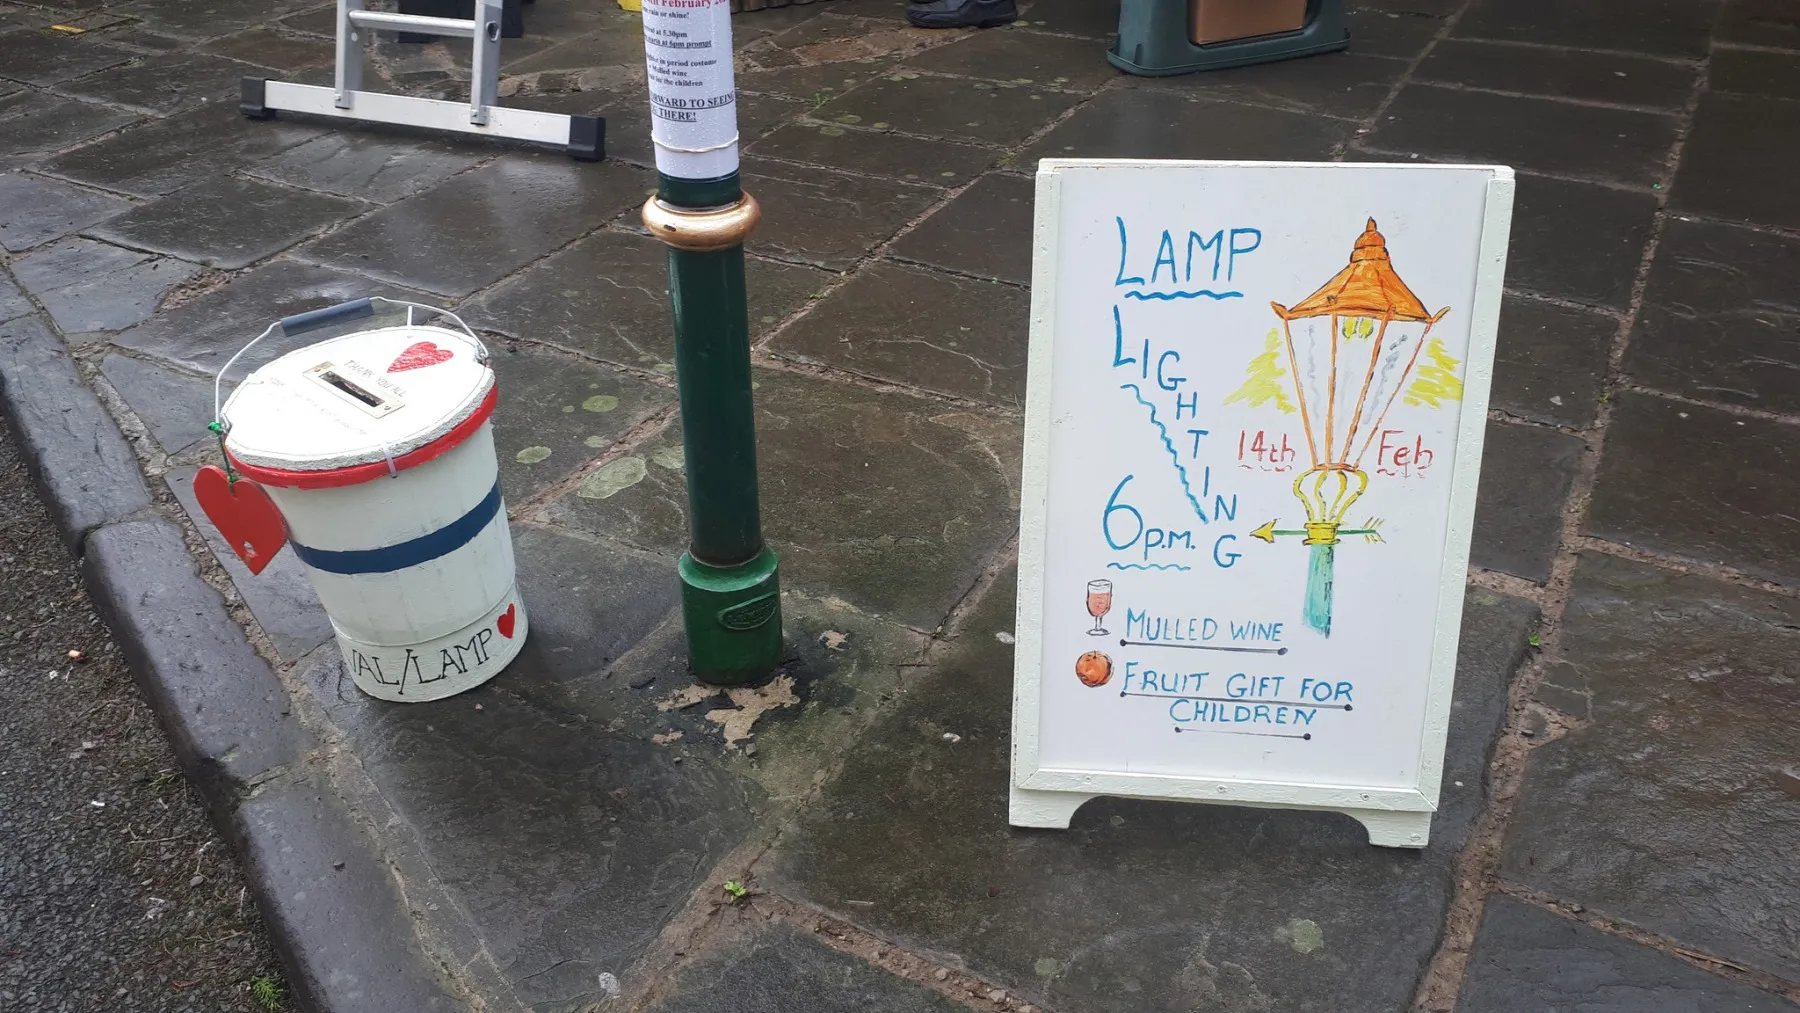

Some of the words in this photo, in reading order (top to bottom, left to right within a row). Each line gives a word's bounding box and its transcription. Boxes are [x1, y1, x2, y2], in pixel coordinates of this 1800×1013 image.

[669, 11, 690, 19] shine!
[663, 29, 688, 39] 5.30pm
[669, 40, 685, 48] 6pm
[686, 40, 712, 49] prompt
[667, 59, 689, 67] period
[672, 69, 688, 77] wine
[675, 79, 703, 87] children
[689, 98, 705, 108] TO
[659, 107, 697, 121] THERE!
[1114, 216, 1262, 286] LAMP
[1112, 304, 1242, 569] LIGHTING
[1237, 430, 1297, 463] 14th
[1126, 607, 1218, 642] MULLED
[1230, 620, 1284, 642] WINE
[1122, 661, 1210, 693] FRUIT
[1226, 672, 1285, 698] GIFT
[1299, 678, 1354, 702] FOR
[1169, 698, 1317, 726] CHILDREN
